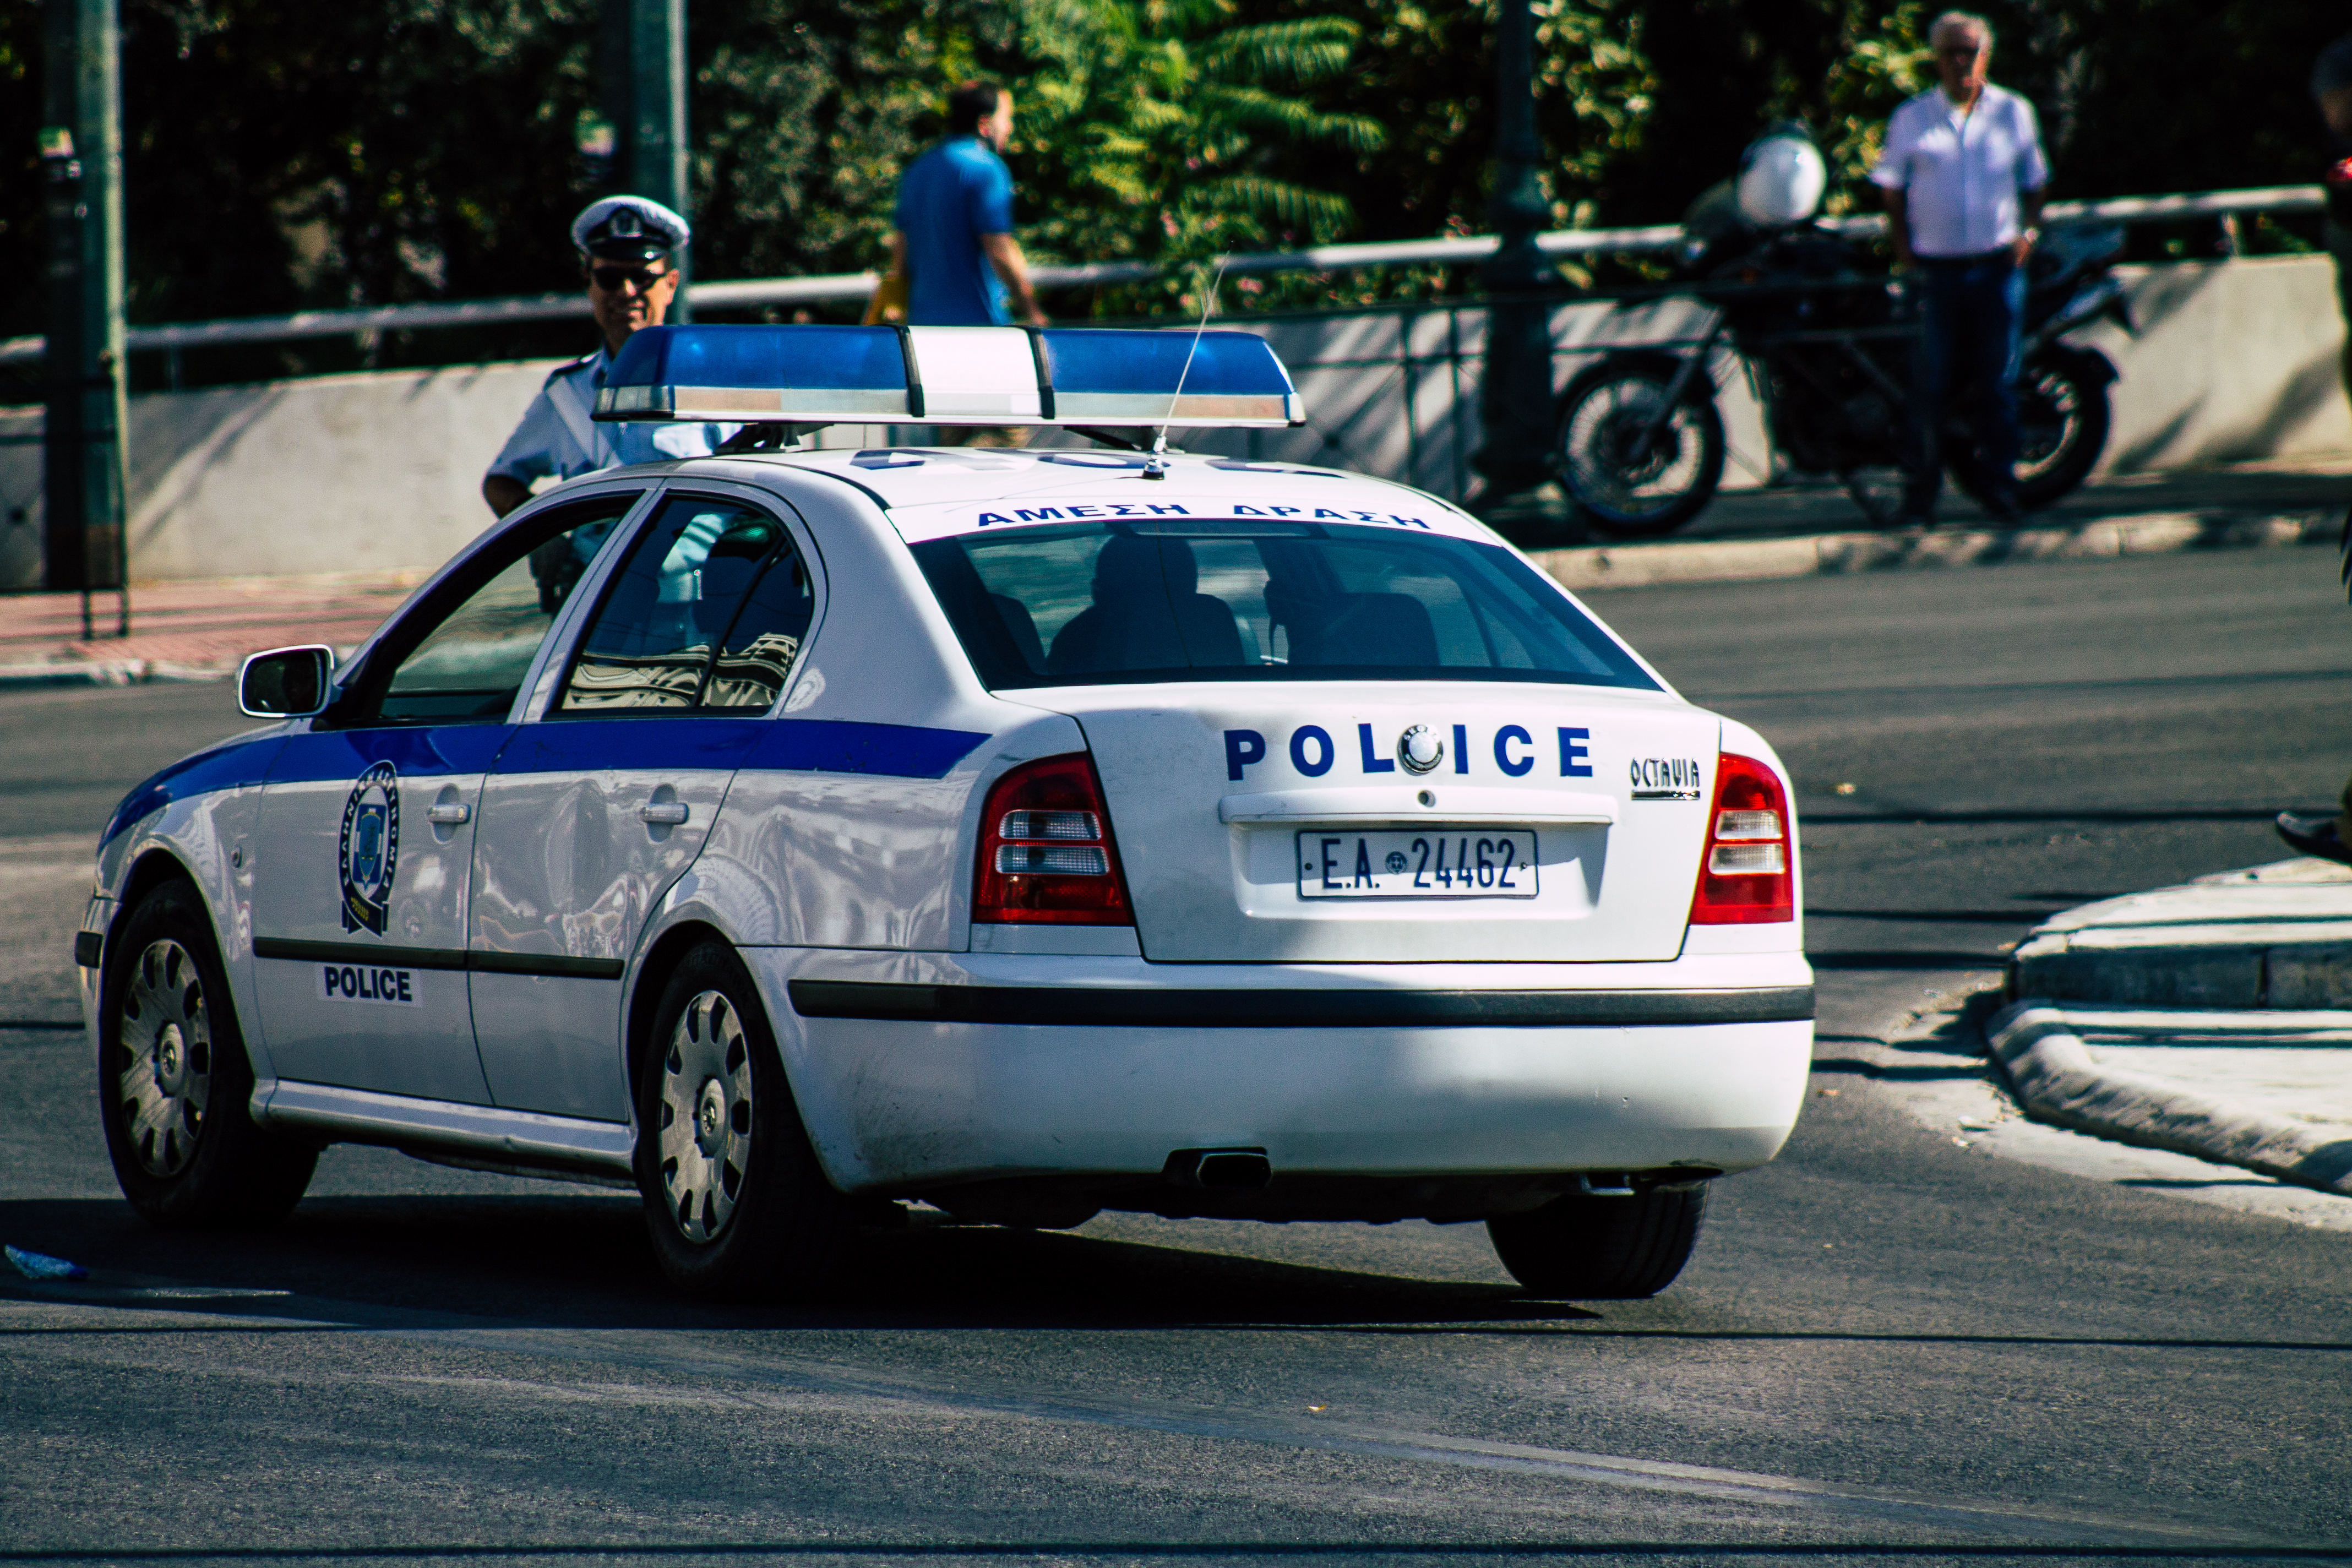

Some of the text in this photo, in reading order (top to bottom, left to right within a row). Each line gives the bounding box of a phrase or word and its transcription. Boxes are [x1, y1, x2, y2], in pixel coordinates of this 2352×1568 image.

[978, 504, 1431, 529] ΑΜΕΣΗ ΔΡΑΣΗ
[1223, 722, 1593, 781] POLICE
[1630, 758, 1700, 787] OCTAVIA
[1411, 837, 1516, 889] 24462
[324, 966, 412, 1001] POLICE
